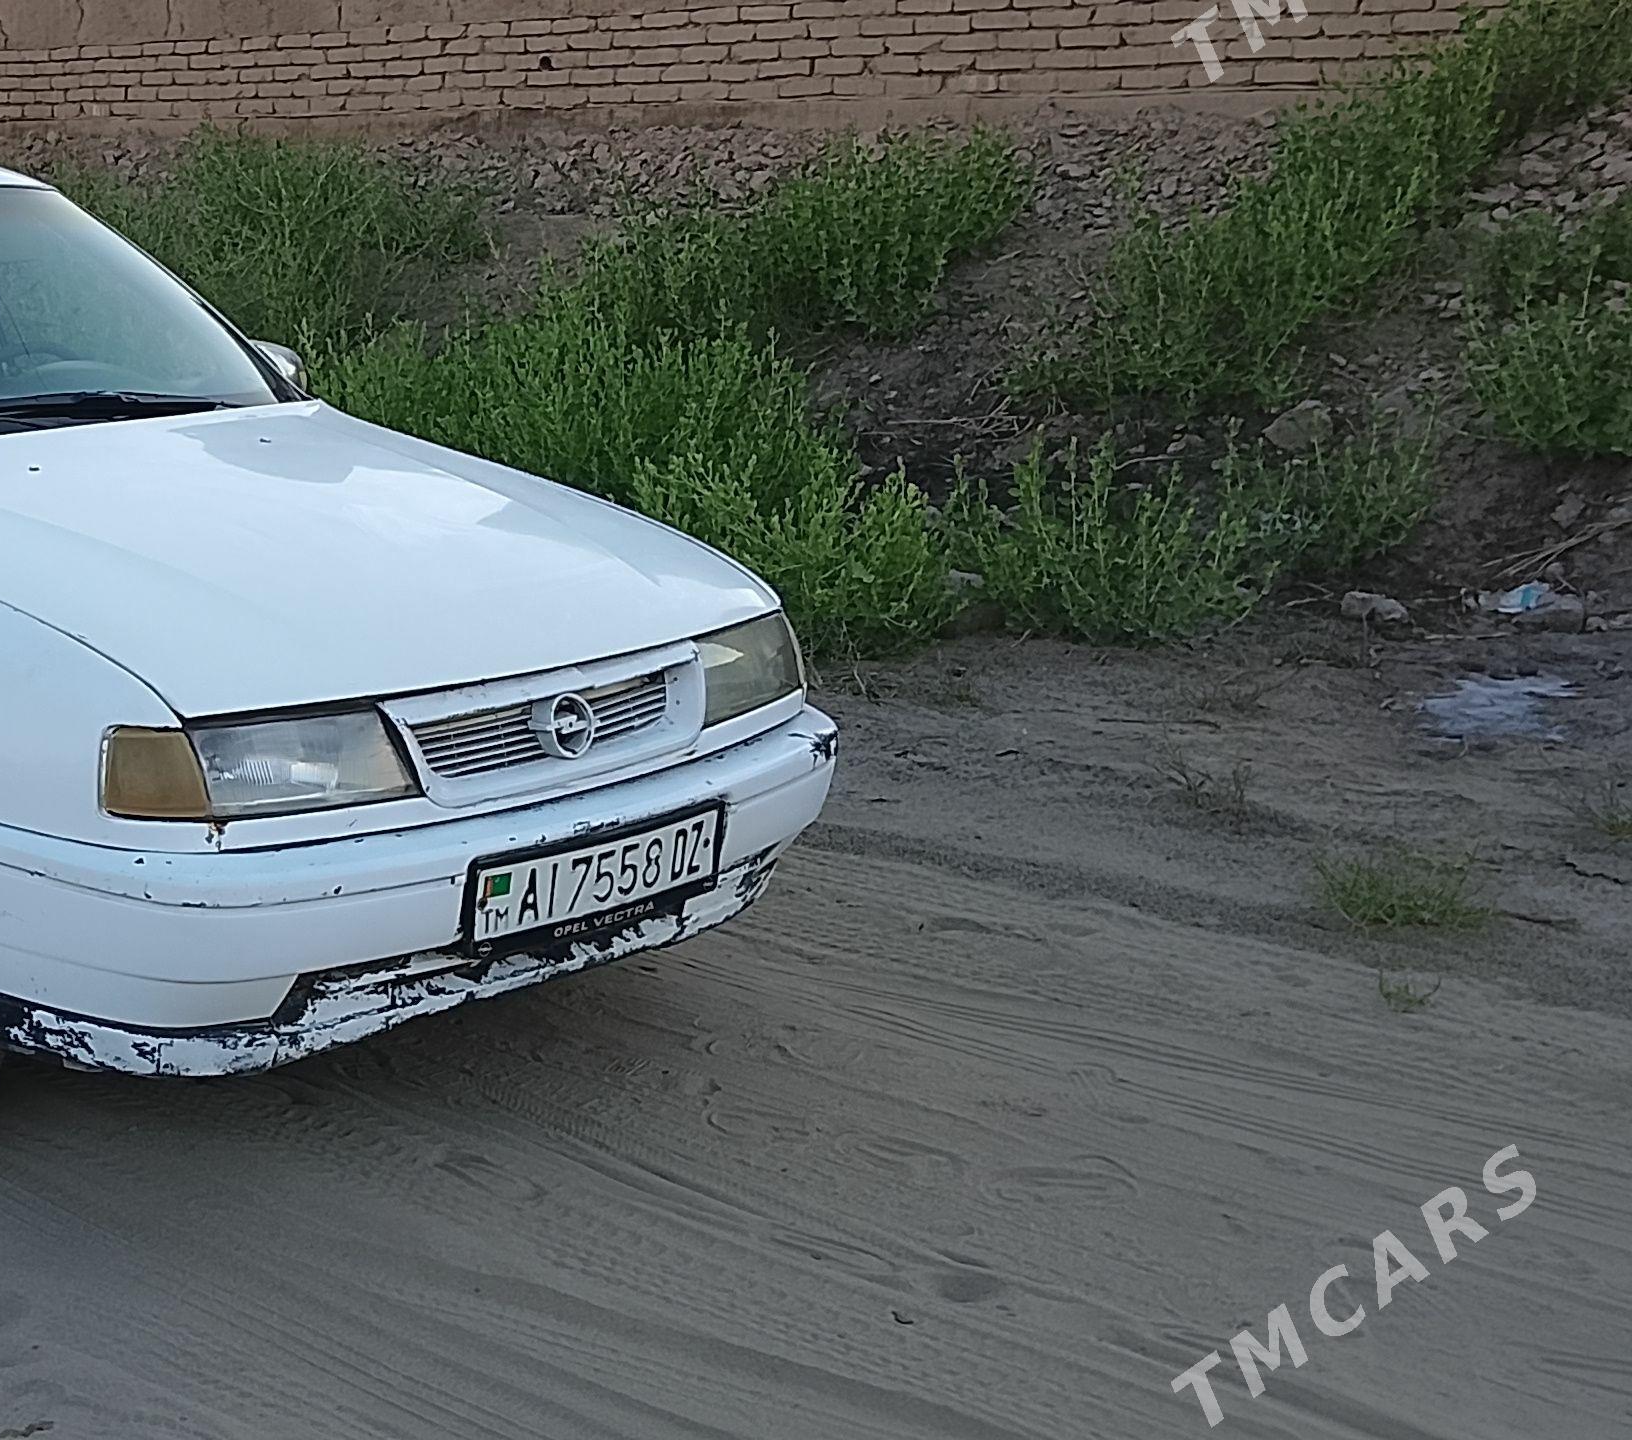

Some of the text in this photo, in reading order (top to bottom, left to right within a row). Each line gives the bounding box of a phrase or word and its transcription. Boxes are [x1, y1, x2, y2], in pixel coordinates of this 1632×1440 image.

[670, 820, 705, 882] DZ
[480, 906, 509, 934] TM
[553, 901, 655, 938] OPEL VECTRA
